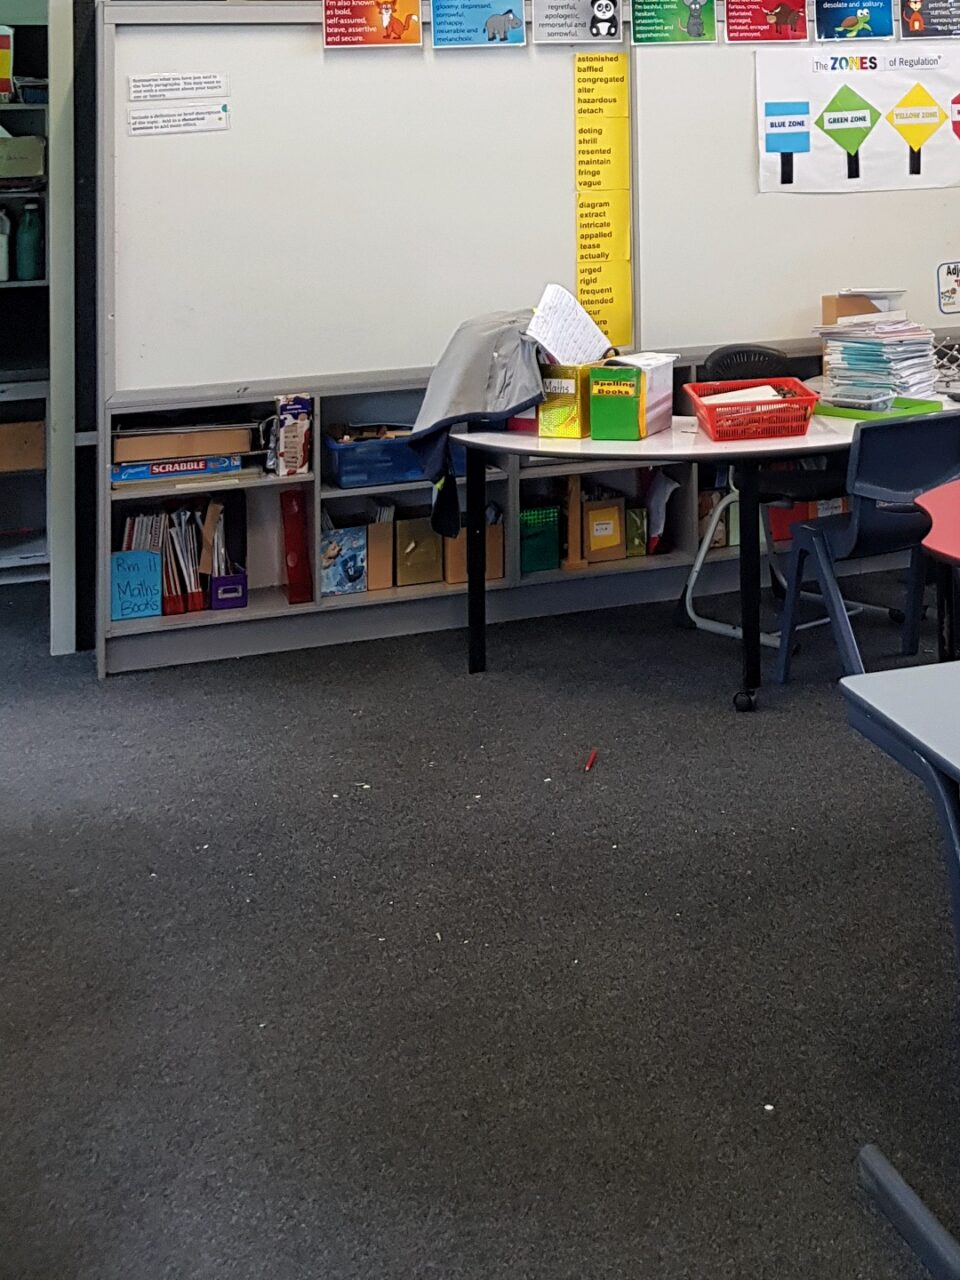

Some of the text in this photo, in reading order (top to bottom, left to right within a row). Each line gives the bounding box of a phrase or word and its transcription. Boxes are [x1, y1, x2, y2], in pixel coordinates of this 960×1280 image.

[815, 61, 828, 70] The
[831, 56, 877, 70] ZONES
[889, 58, 897, 66] of
[578, 76, 624, 84] congregated
[580, 252, 609, 260] actually
[580, 266, 602, 274] urged
[580, 277, 597, 285] rigid
[580, 288, 612, 296] frequent
[545, 380, 569, 392] Maths
[152, 462, 205, 473] SCRABBLE
[117, 557, 139, 571] Rm
[118, 582, 159, 600] Maths
